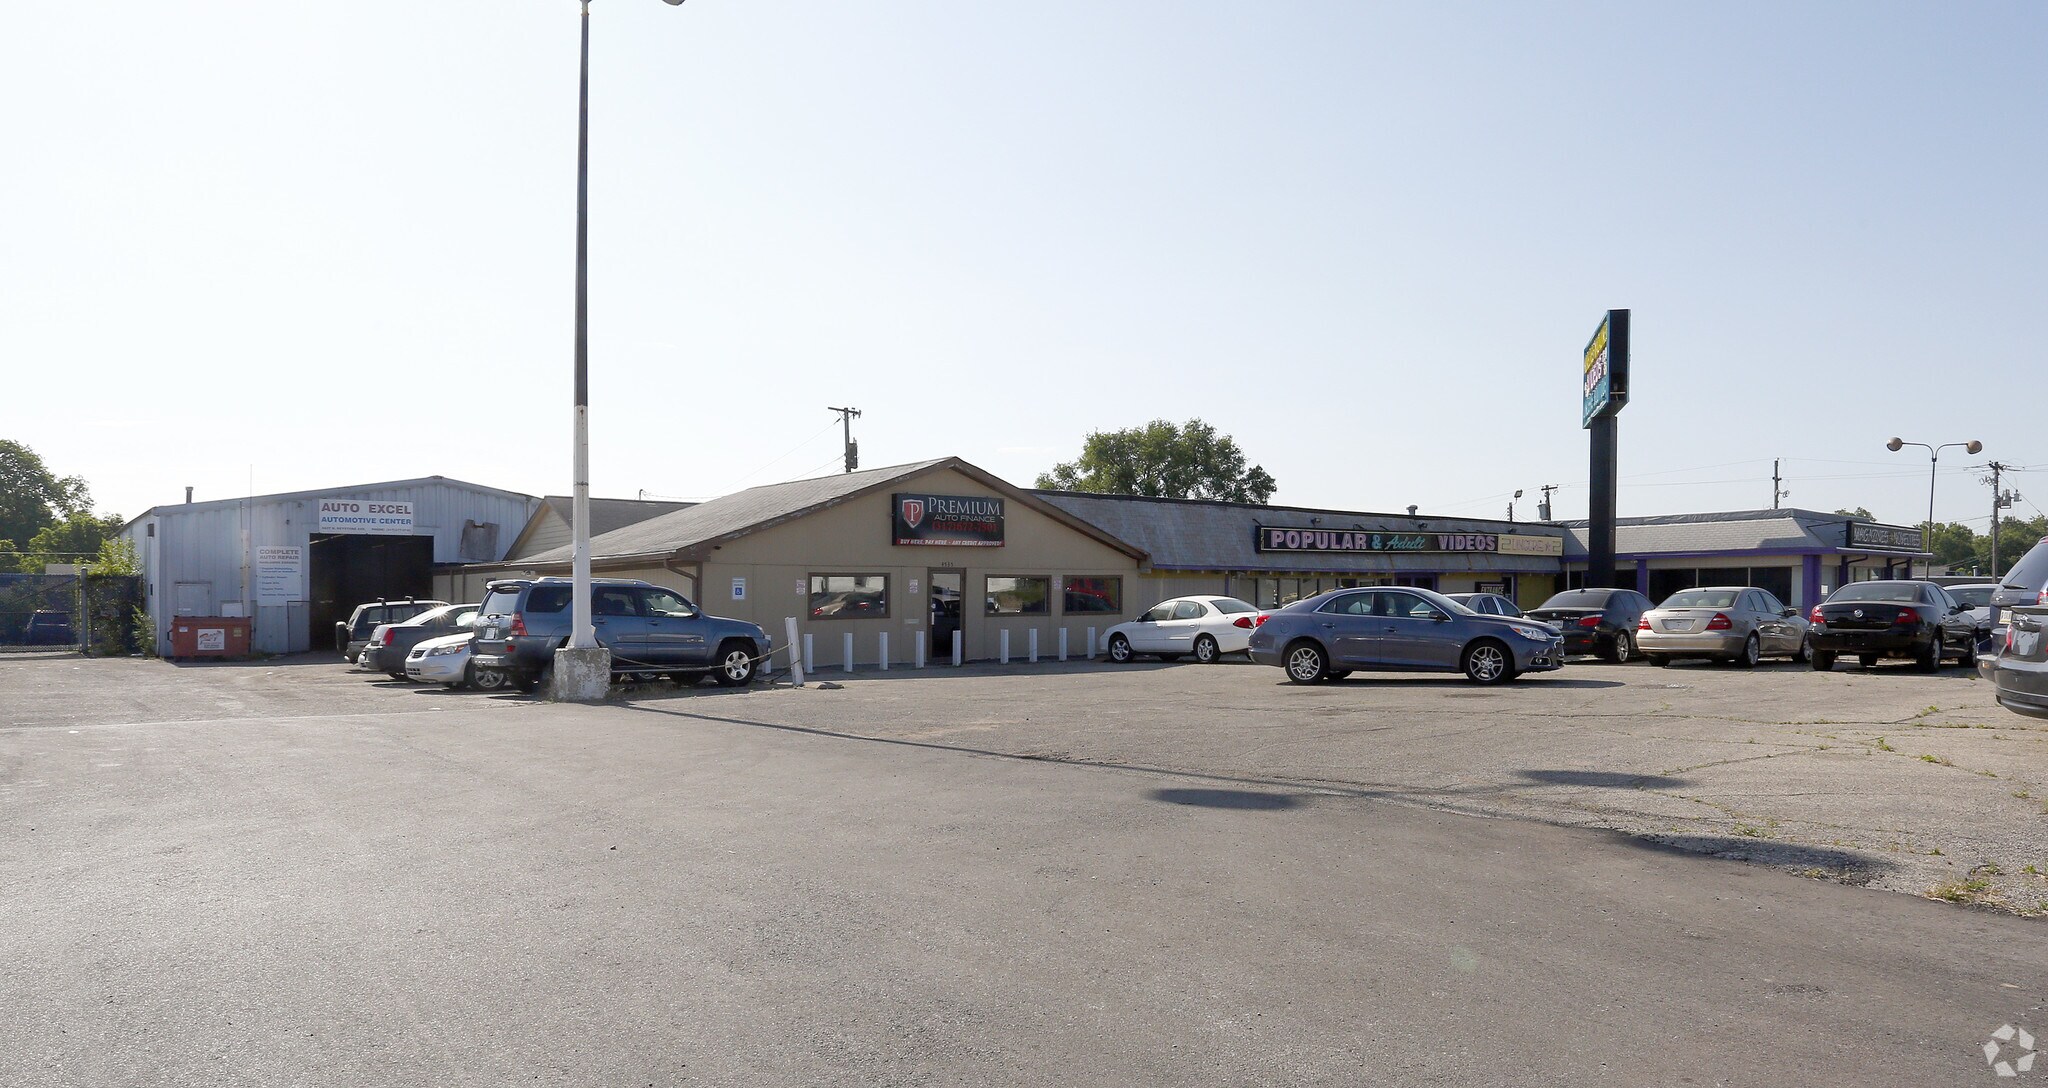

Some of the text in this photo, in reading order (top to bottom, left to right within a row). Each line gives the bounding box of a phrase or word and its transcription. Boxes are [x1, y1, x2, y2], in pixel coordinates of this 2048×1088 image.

[321, 503, 412, 515] AUTO EXCEL
[928, 497, 1001, 515] PREMIUM
[910, 503, 920, 522] P
[321, 516, 377, 524] AUTOMOTIVE
[960, 515, 996, 523] FINANCE
[1270, 530, 1496, 551] POPULAR & Adult VIDEOS
[1480, 586, 1504, 594] ENTRANCE
